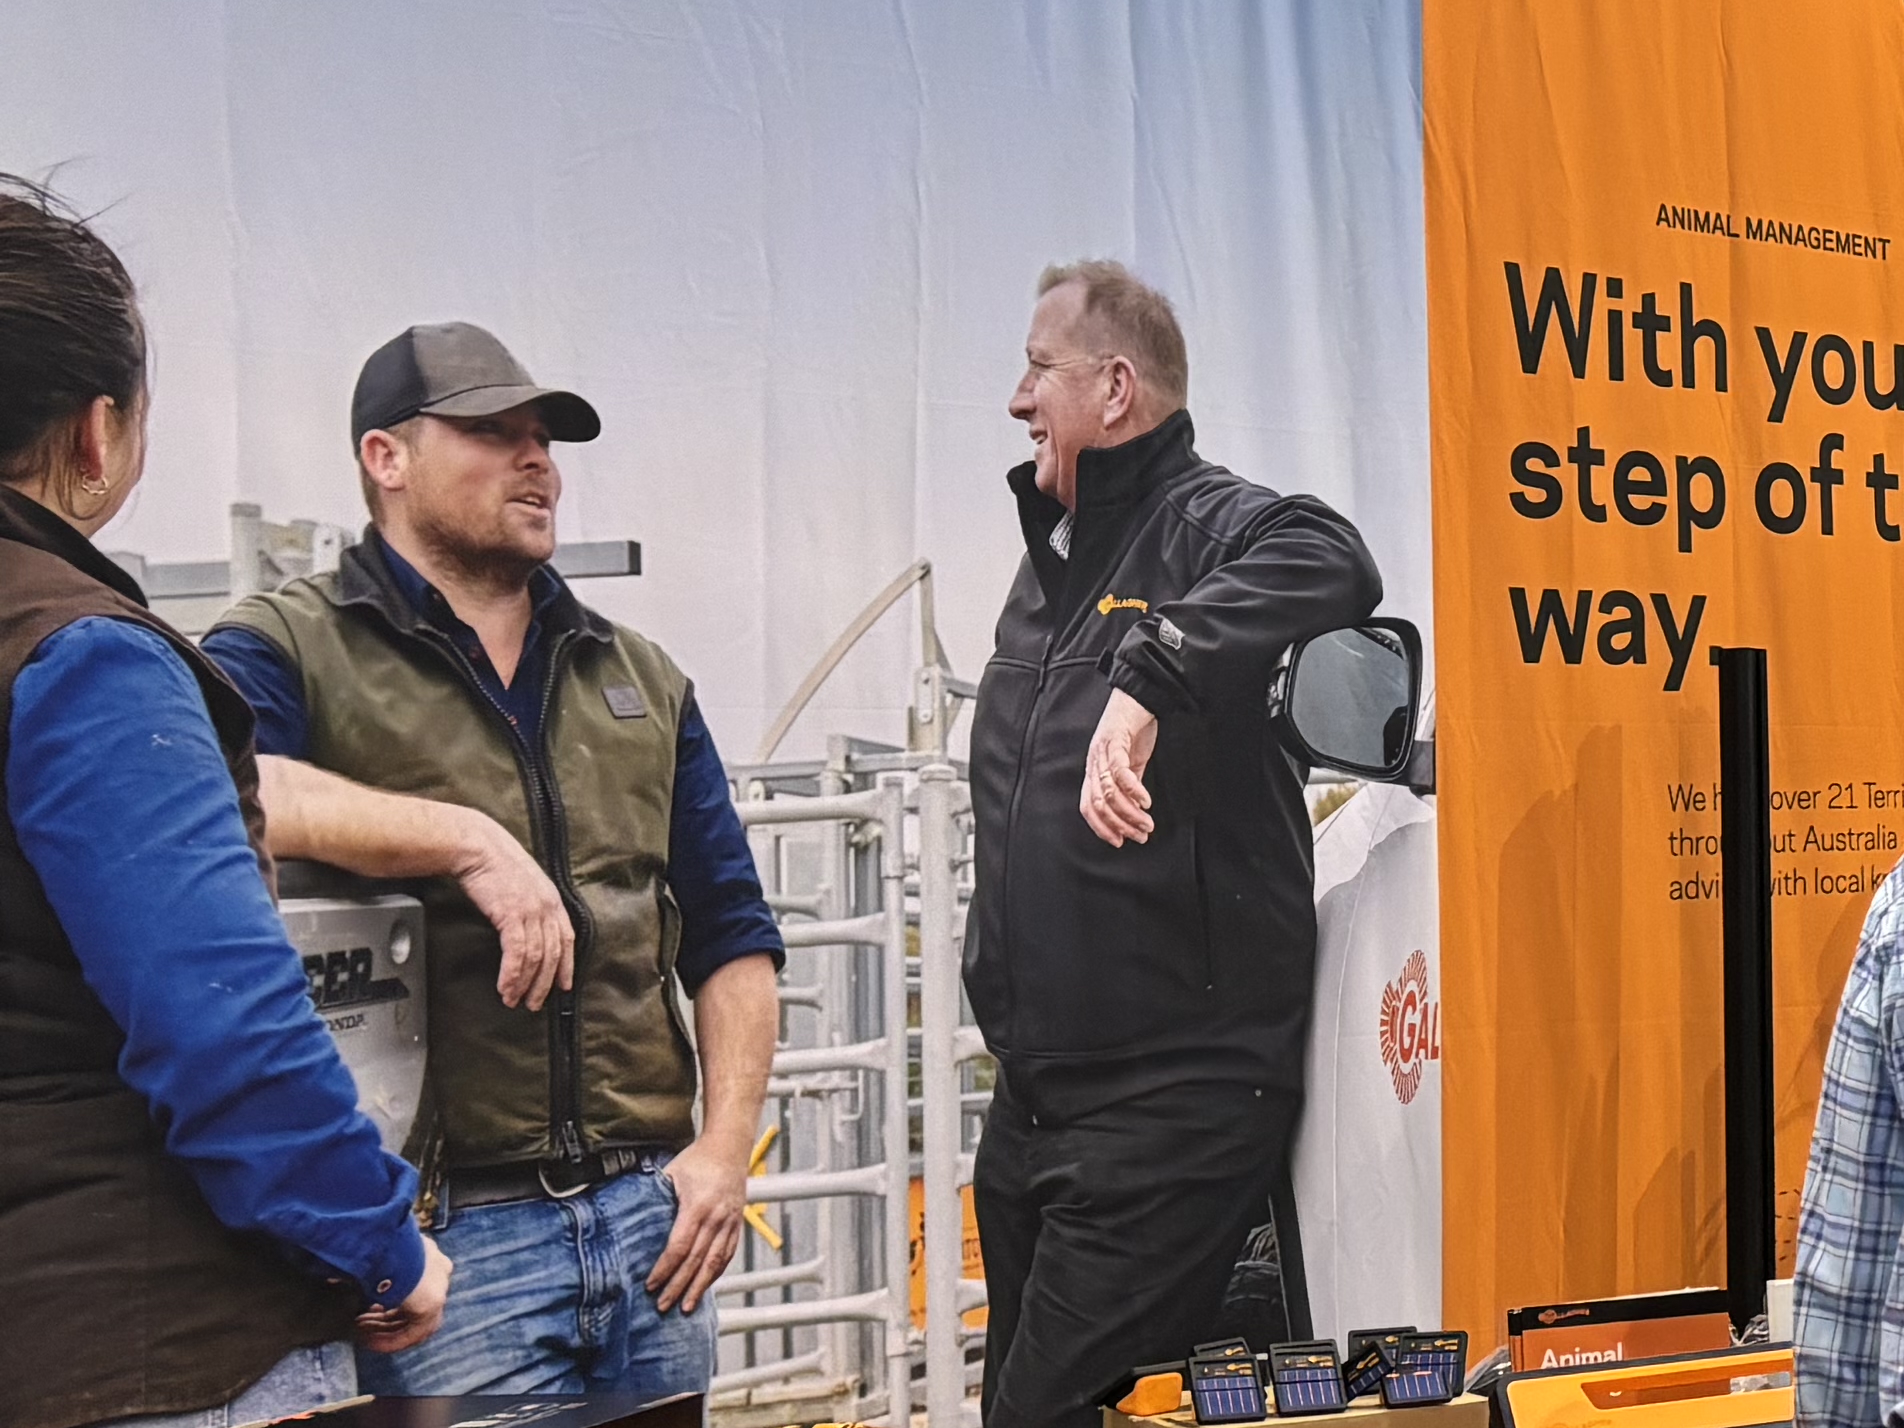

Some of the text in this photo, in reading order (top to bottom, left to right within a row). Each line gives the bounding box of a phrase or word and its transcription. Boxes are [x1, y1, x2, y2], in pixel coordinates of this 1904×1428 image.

[1656, 203, 1891, 261] ANIMAL MANAGEMENT
[1503, 260, 1728, 393] With
[1509, 425, 1727, 553] step
[1754, 433, 1844, 536] of
[1667, 782, 1707, 813] We
[1771, 788, 1822, 811] over
[1827, 782, 1859, 810] 21
[1803, 824, 1898, 853] Australia
[1669, 872, 1721, 901] advi
[1814, 864, 1865, 897] local
[1540, 1342, 1623, 1369] Animal
